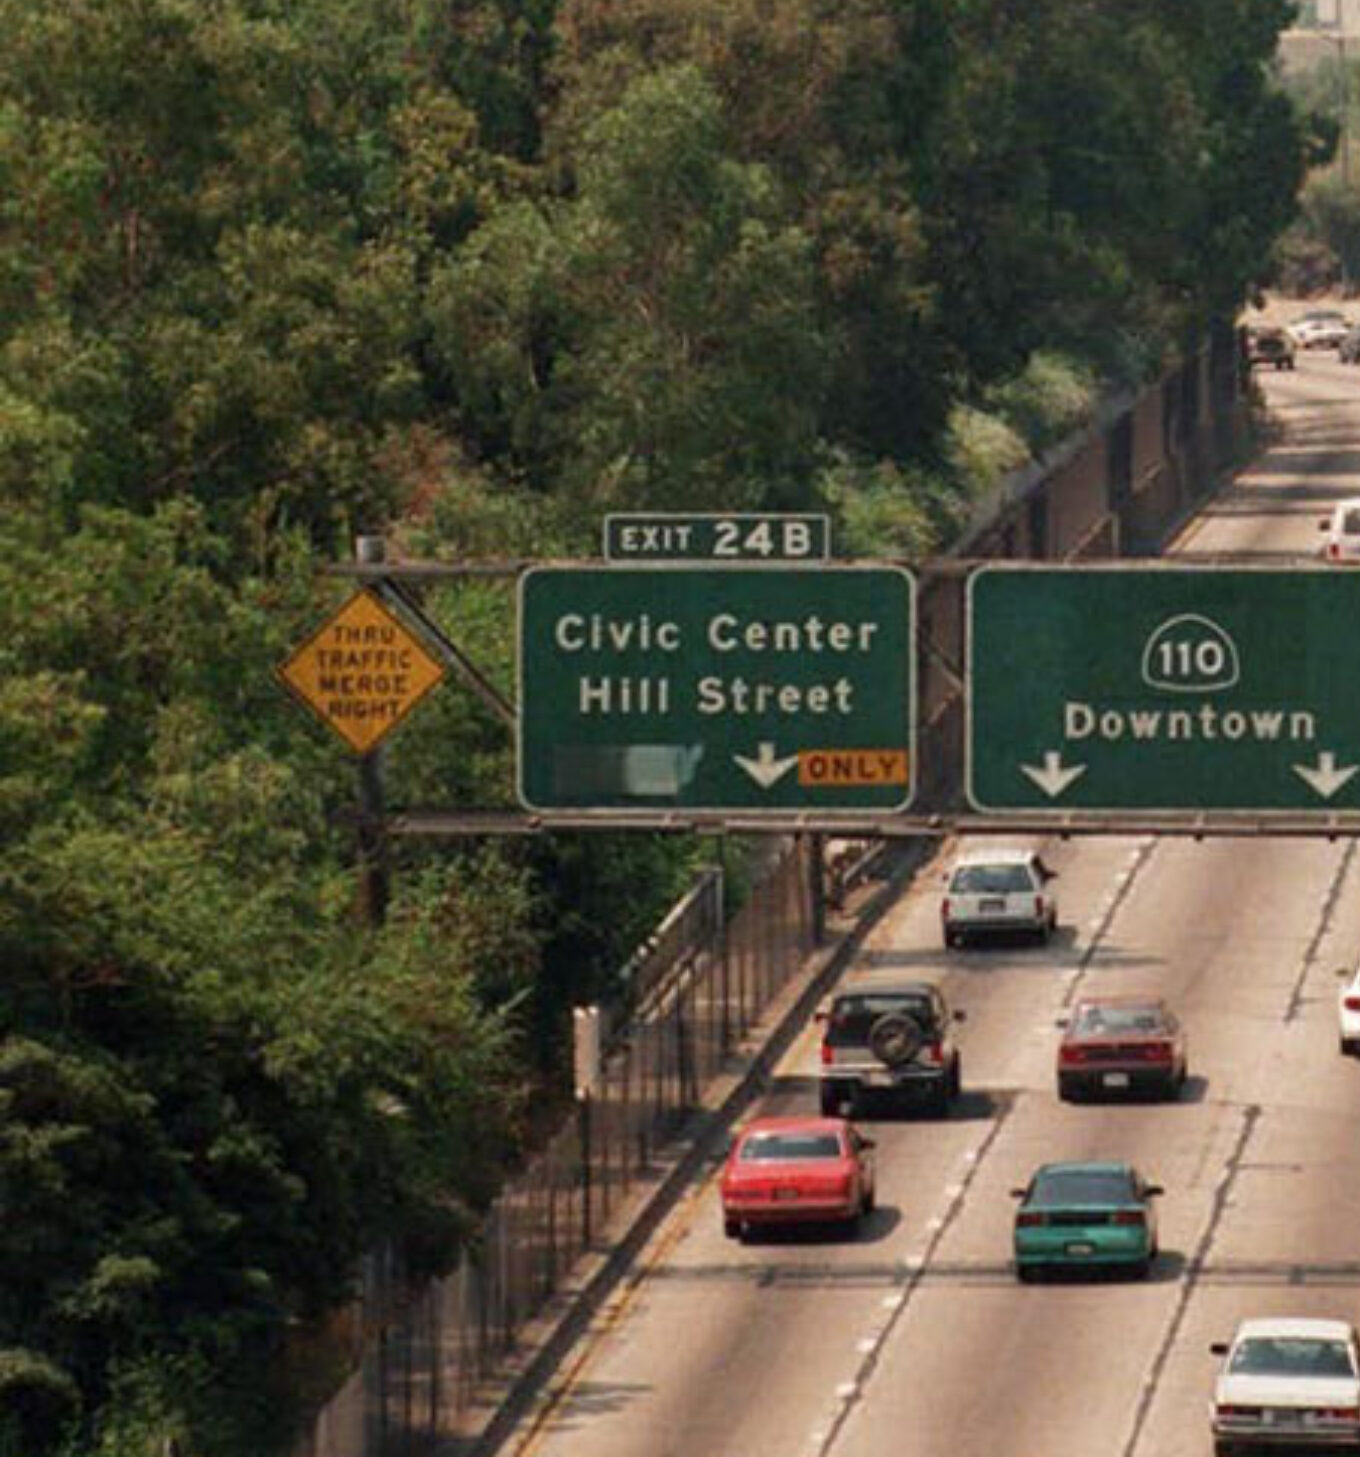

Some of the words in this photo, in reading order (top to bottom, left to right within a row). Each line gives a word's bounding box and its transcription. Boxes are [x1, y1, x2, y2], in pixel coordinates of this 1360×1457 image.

[621, 525, 692, 551] EXIT
[712, 522, 811, 556] 24B
[333, 625, 396, 645] THRU
[556, 613, 681, 651] Civic
[708, 613, 879, 651] Center
[316, 649, 411, 670] TRAFFIC
[1159, 640, 1225, 676] 110
[318, 674, 408, 696] MERGE
[579, 676, 670, 714] Hill
[697, 676, 854, 714] Street
[328, 700, 398, 719] RIGHT
[1063, 702, 1316, 740] Downtown
[808, 754, 899, 781] ONLY
